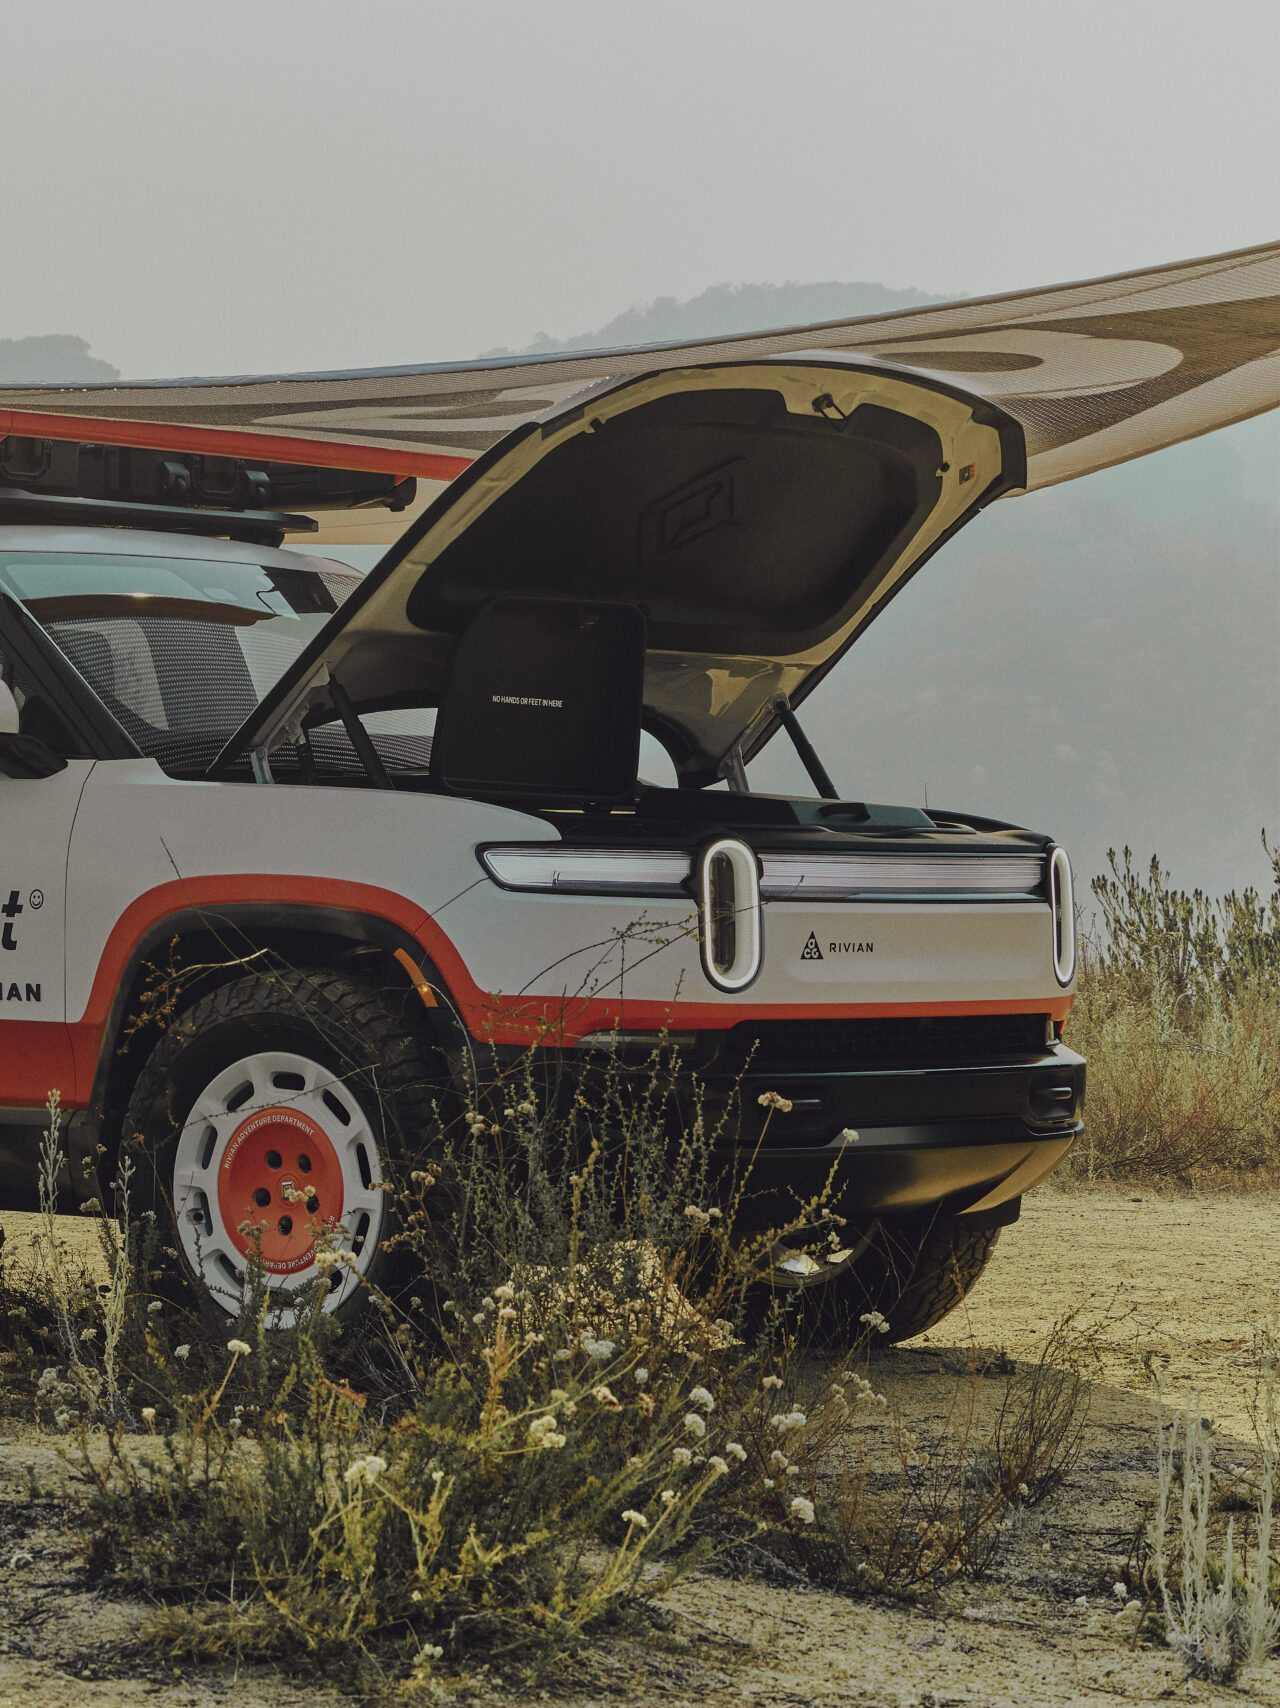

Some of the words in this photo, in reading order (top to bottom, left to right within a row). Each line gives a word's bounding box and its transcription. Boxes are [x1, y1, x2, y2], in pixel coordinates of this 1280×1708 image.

[492, 695, 501, 703] NO
[501, 696, 520, 704] HANDS
[520, 697, 528, 705] OR
[529, 698, 542, 706] FEET
[549, 700, 563, 708] HERE
[829, 942, 874, 953] RIVIAN
[224, 1142, 238, 1169] RIVIAN
[237, 1116, 271, 1144] ADVENTURE
[272, 1115, 315, 1136] DEPARTMENT
